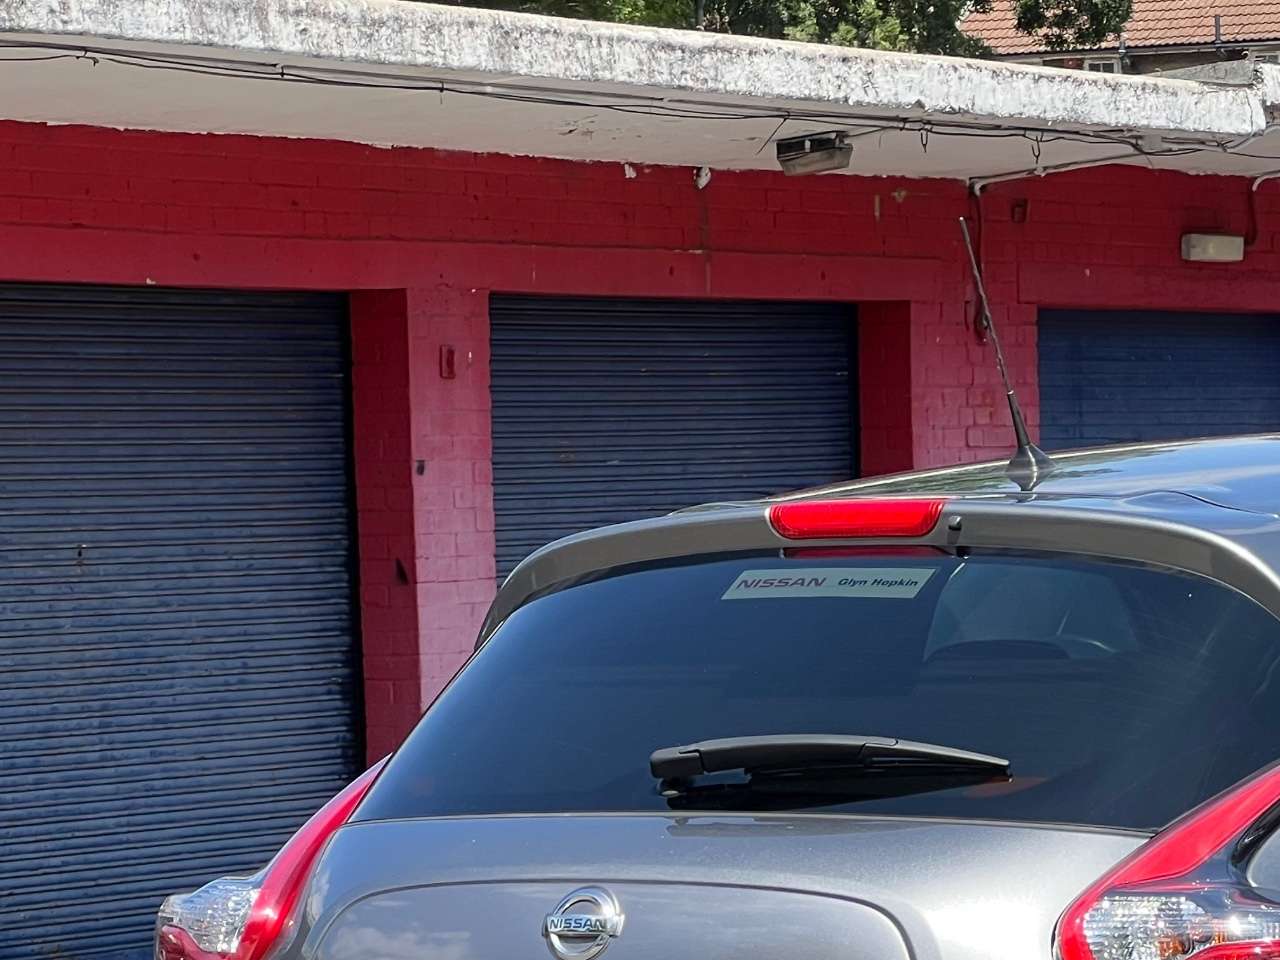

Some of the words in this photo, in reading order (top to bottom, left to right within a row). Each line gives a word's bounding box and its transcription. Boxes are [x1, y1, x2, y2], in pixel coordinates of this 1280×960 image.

[735, 576, 827, 589] NISSAN
[837, 577, 868, 588] Glyn
[870, 577, 919, 588] Hopkin
[549, 918, 608, 930] NISSAN
